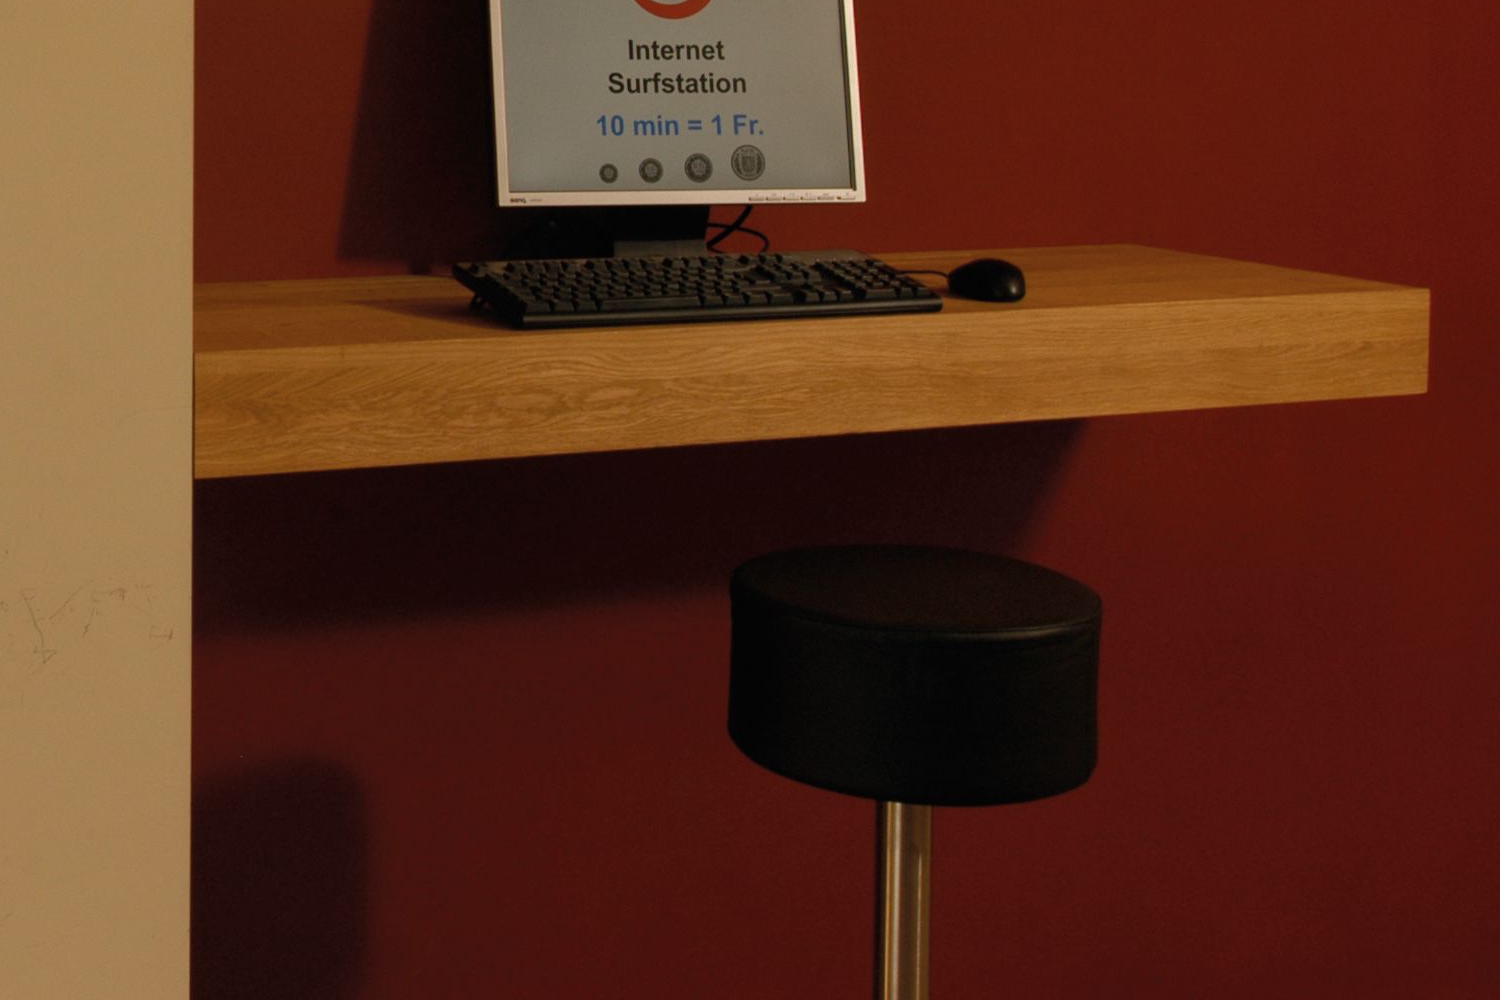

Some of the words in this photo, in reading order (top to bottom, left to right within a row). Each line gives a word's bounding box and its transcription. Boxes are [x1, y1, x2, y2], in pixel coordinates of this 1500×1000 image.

[628, 39, 725, 60] Internet
[608, 72, 747, 94] Surfstation
[597, 114, 625, 136] 10
[633, 115, 680, 136] min
[687, 119, 703, 130] =
[711, 114, 723, 136] 1
[733, 114, 764, 136] Fr.
